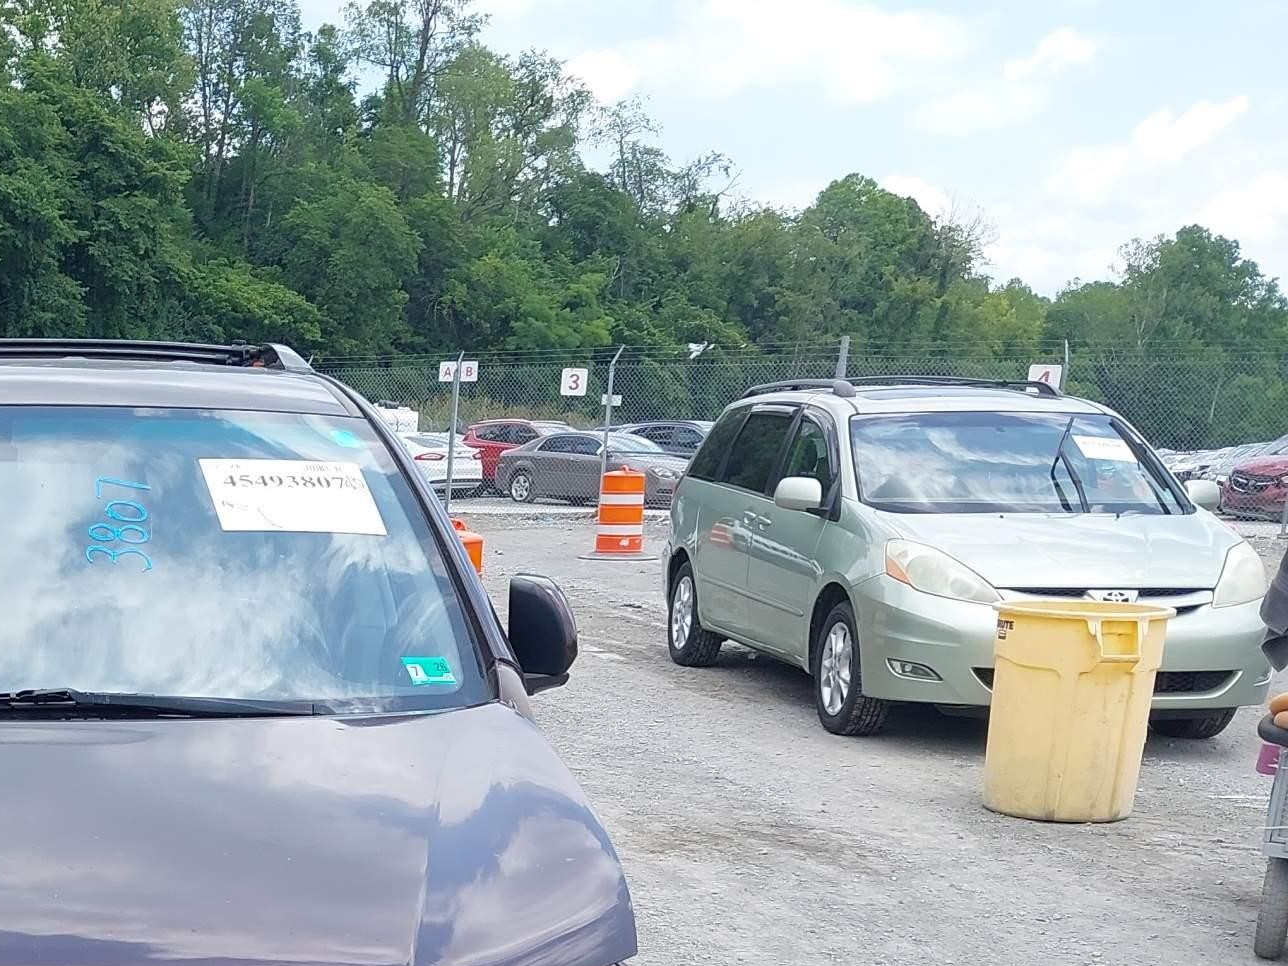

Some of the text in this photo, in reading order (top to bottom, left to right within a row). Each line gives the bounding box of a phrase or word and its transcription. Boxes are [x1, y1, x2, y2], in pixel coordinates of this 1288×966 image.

[444, 366, 473, 377] A B
[568, 373, 580, 391] 3
[86, 477, 153, 572] 3807
[410, 666, 418, 676] 7
